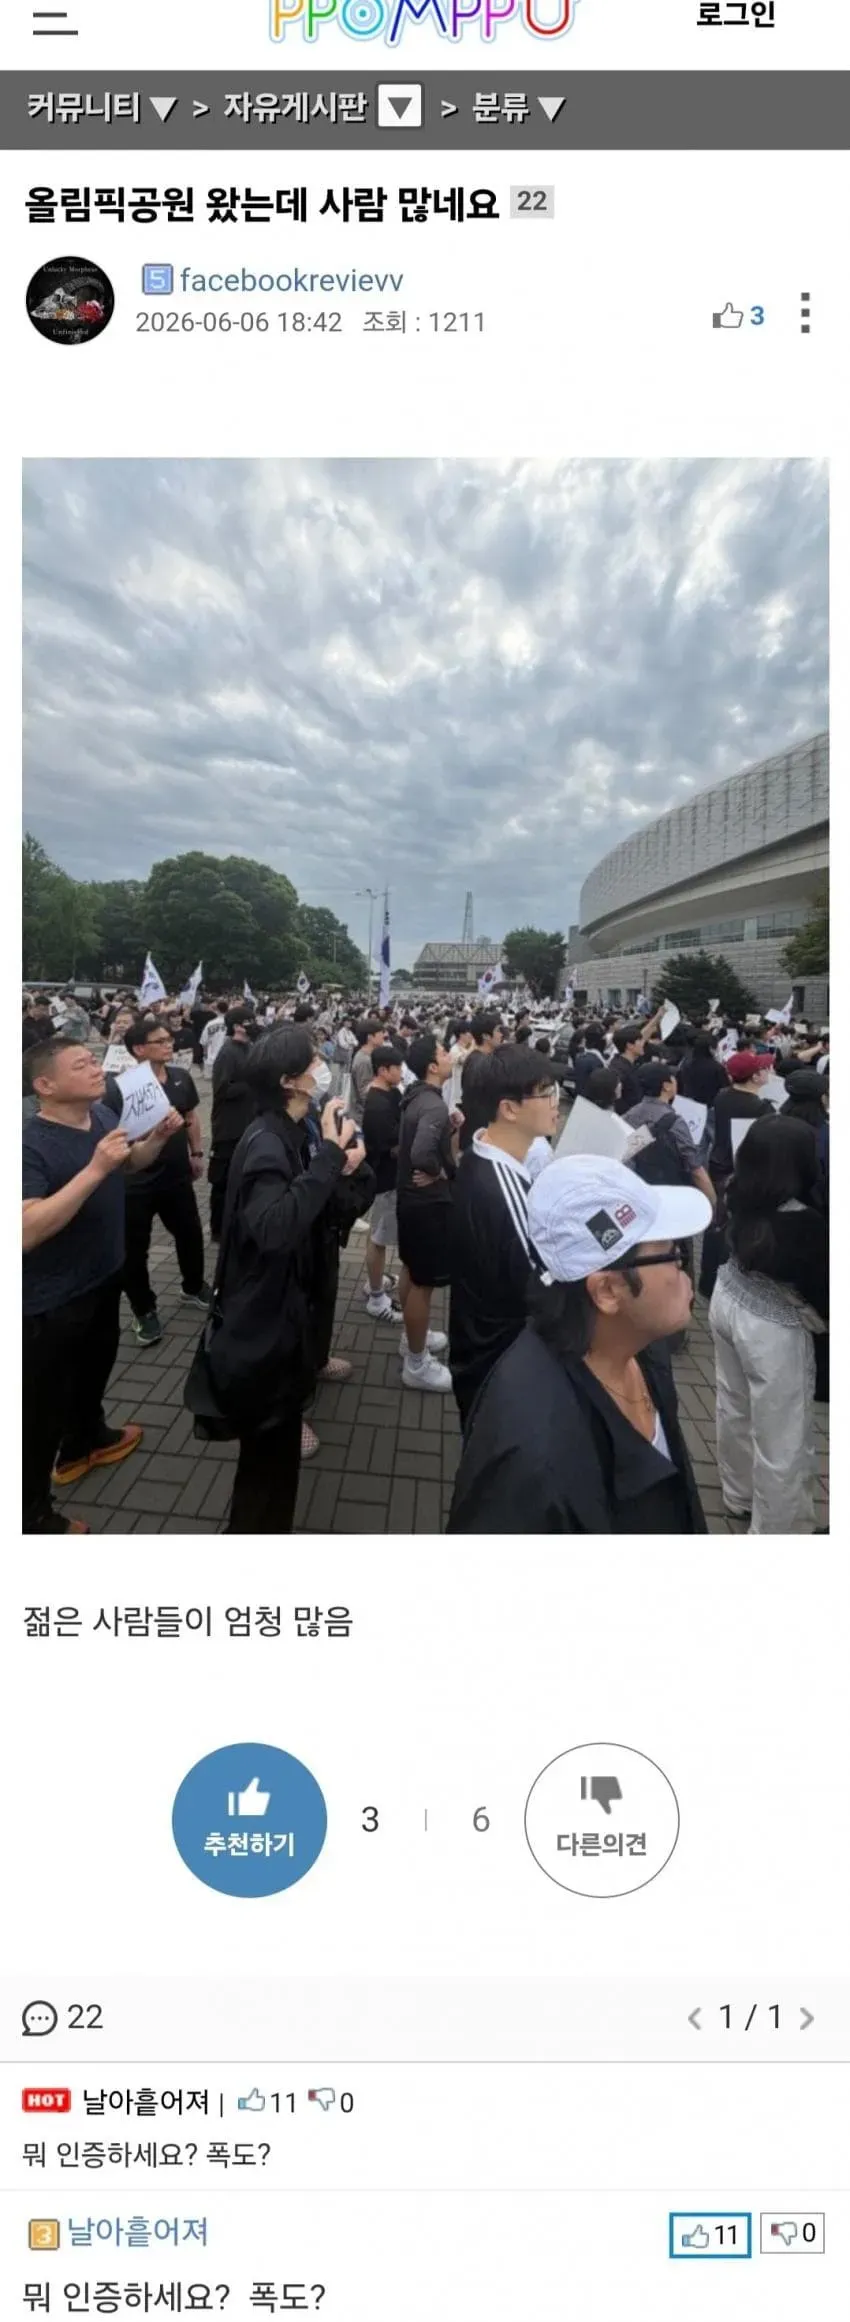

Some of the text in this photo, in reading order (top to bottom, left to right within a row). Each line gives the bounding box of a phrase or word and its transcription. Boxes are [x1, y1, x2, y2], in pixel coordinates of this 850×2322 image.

[697, 1, 776, 28] 로그인
[27, 91, 140, 123] 커뮤니티
[223, 91, 368, 123] 자유게시판
[472, 92, 530, 123] 분류
[25, 187, 500, 223] 올림픽공원 왔는데 사람 많네요
[517, 190, 548, 211] 22
[180, 266, 404, 292] facebookrevievv
[136, 311, 343, 332] 2026-06-06 18:42
[363, 310, 406, 334] 조회
[429, 311, 485, 332] 1211
[750, 305, 765, 326] 3
[24, 1606, 354, 1637] 젊은 사람들이 엄청 많음
[361, 1805, 379, 1833] 3
[472, 1805, 491, 1833] 6
[203, 1831, 294, 1857] 추천하기
[556, 1832, 647, 1857] 다른의견
[67, 2003, 104, 2030] 22
[28, 2094, 65, 2106] HOT
[83, 2088, 209, 2116] 날아흩어져
[270, 2092, 295, 2114] 11
[340, 2091, 354, 2114] 0
[23, 2141, 271, 2168] 뭐 인증하세요? 폭도?
[68, 2216, 207, 2247] 날아흩어져
[714, 2224, 737, 2246] 11
[802, 2222, 817, 2243] 0
[23, 2281, 326, 2313] 뭐 인증하세요? 폭도?
